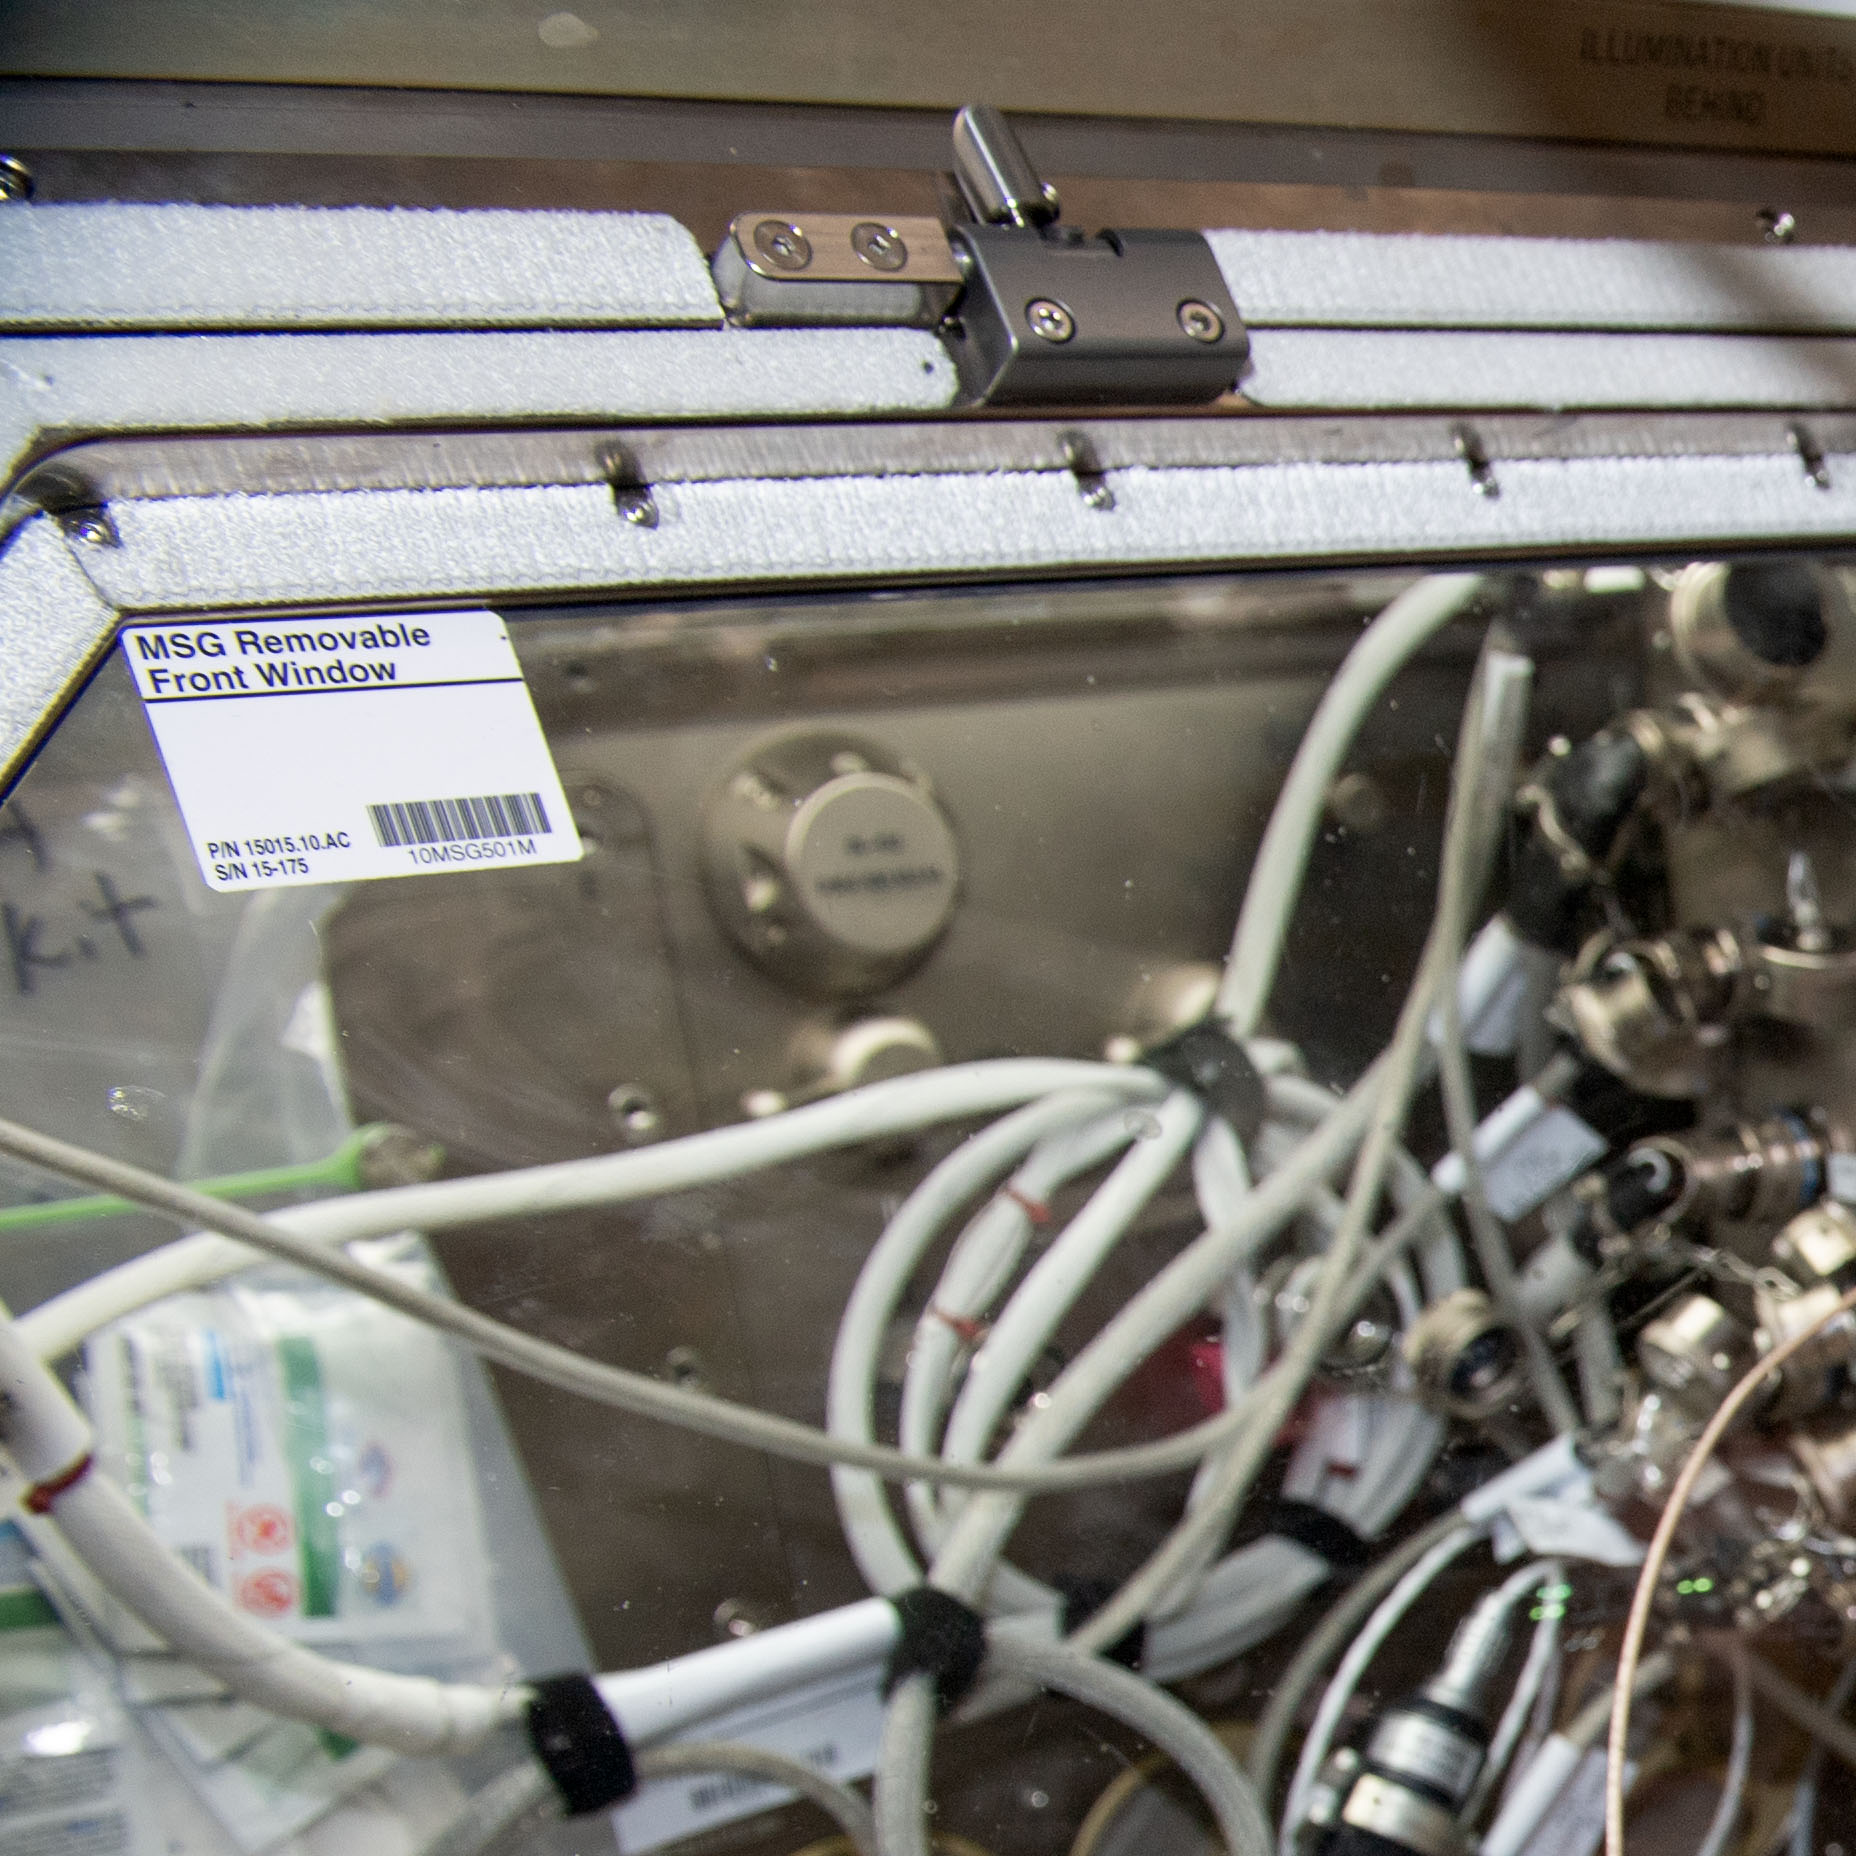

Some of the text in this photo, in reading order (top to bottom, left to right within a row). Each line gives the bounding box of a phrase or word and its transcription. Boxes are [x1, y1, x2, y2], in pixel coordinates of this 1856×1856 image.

[1664, 83, 1766, 127] BEHIND
[136, 622, 431, 661] MSG Removable
[147, 657, 396, 695] Front Window
[207, 831, 351, 859] P/N 15015.10.AC
[407, 839, 537, 866] 10MSG501M
[215, 857, 310, 882] S/N 15-175
